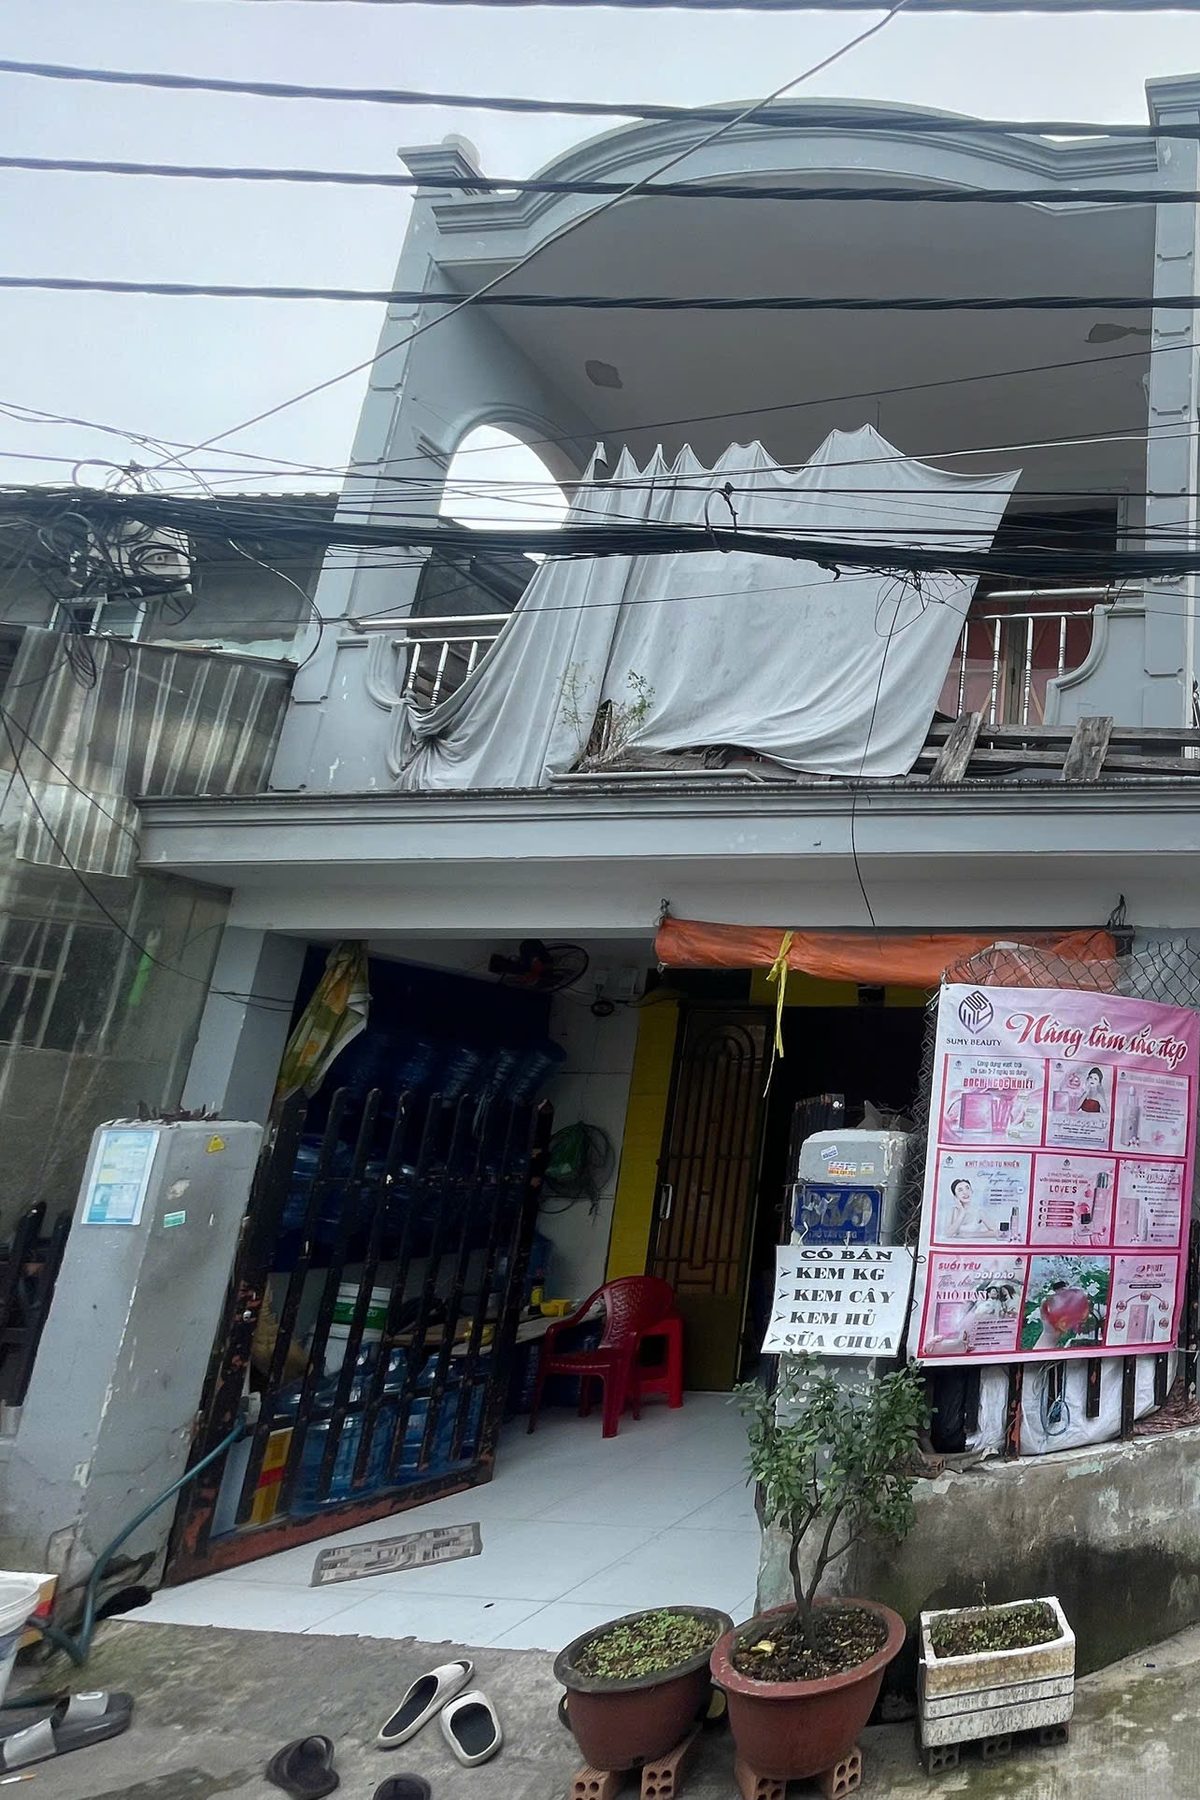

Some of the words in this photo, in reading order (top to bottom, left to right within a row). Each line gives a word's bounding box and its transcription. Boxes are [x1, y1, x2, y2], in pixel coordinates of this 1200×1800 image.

[1006, 1013, 1082, 1058] Nâng
[1086, 1018, 1125, 1051] tầm
[1128, 1025, 1157, 1054] sắc
[1157, 1036, 1188, 1069] đẹp
[801, 1248, 833, 1259] CÓ
[841, 1248, 893, 1260] BÁN
[796, 1267, 845, 1280] KEM
[853, 1268, 885, 1281] KG
[794, 1289, 842, 1302] KEM
[849, 1287, 895, 1303] CÂY
[790, 1311, 838, 1325] KEM
[845, 1309, 877, 1325] HỦ
[783, 1331, 825, 1347] SỮA
[833, 1335, 893, 1349] CHUA
